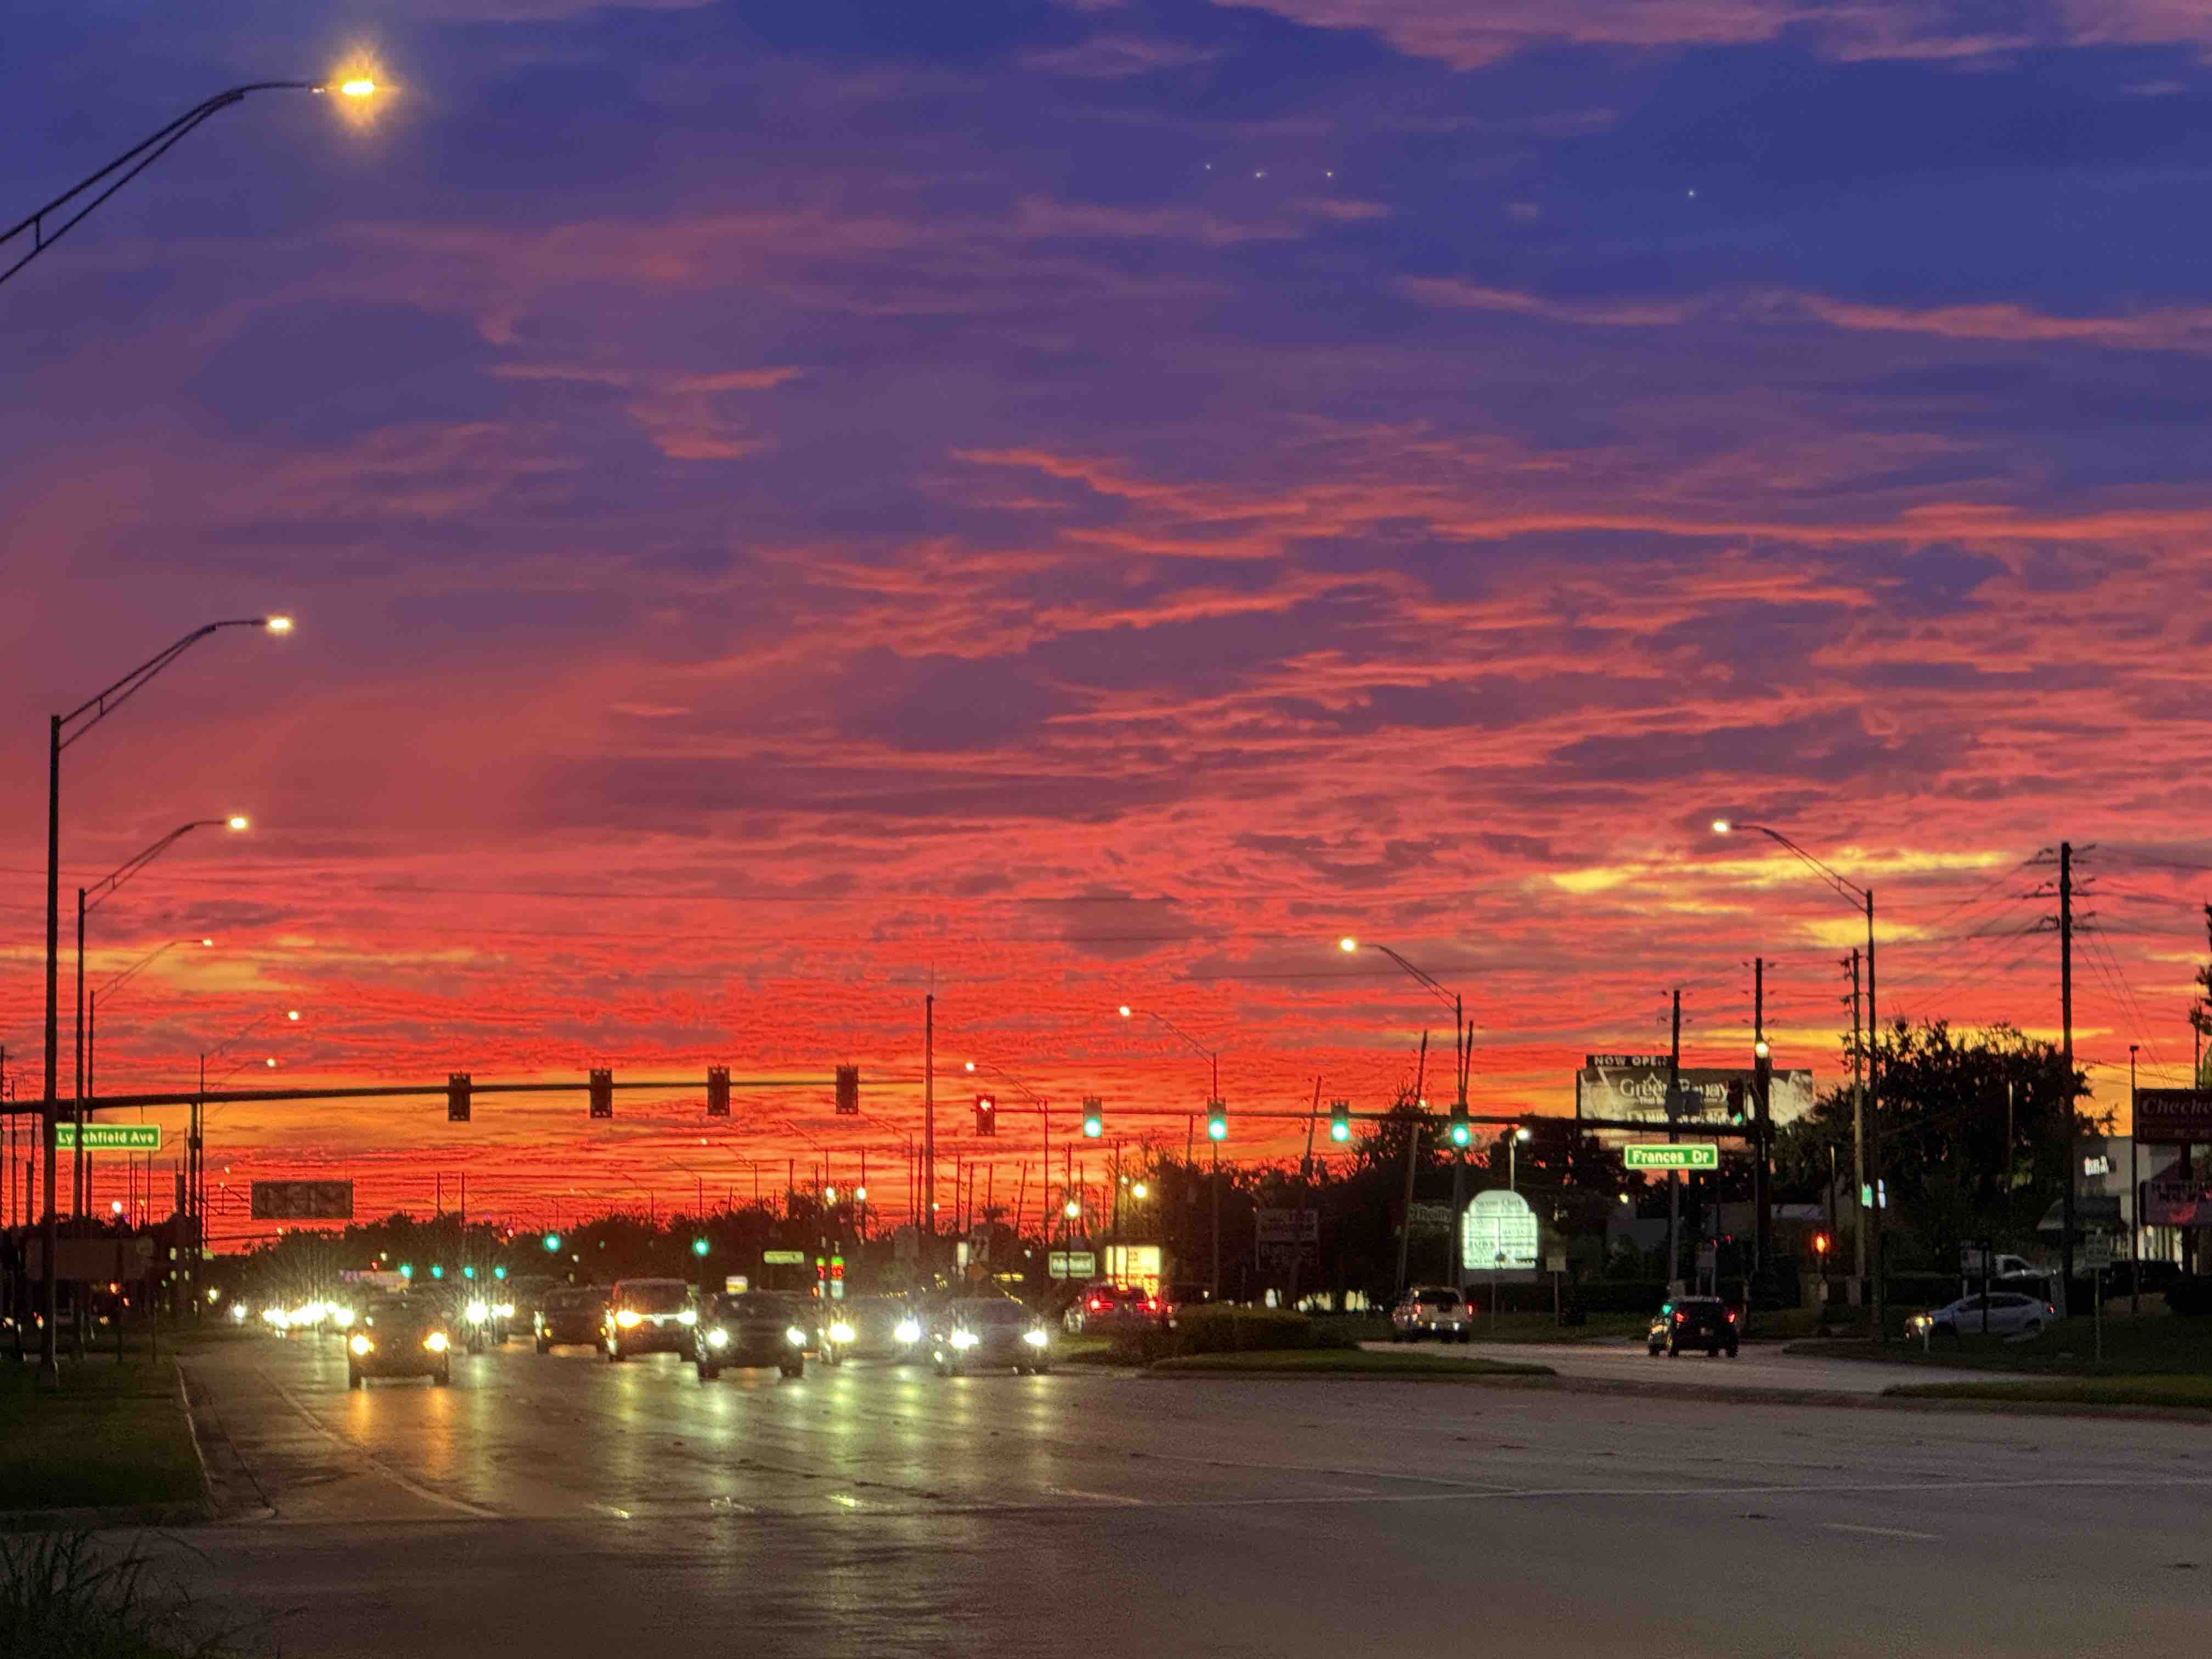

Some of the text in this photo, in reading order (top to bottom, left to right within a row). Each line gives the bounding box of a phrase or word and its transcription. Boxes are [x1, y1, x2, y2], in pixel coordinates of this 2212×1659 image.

[1594, 1056, 1626, 1066] NOW
[58, 1131, 154, 1145] Lychfield Ave
[1633, 1149, 1709, 1164] Frances Dr
